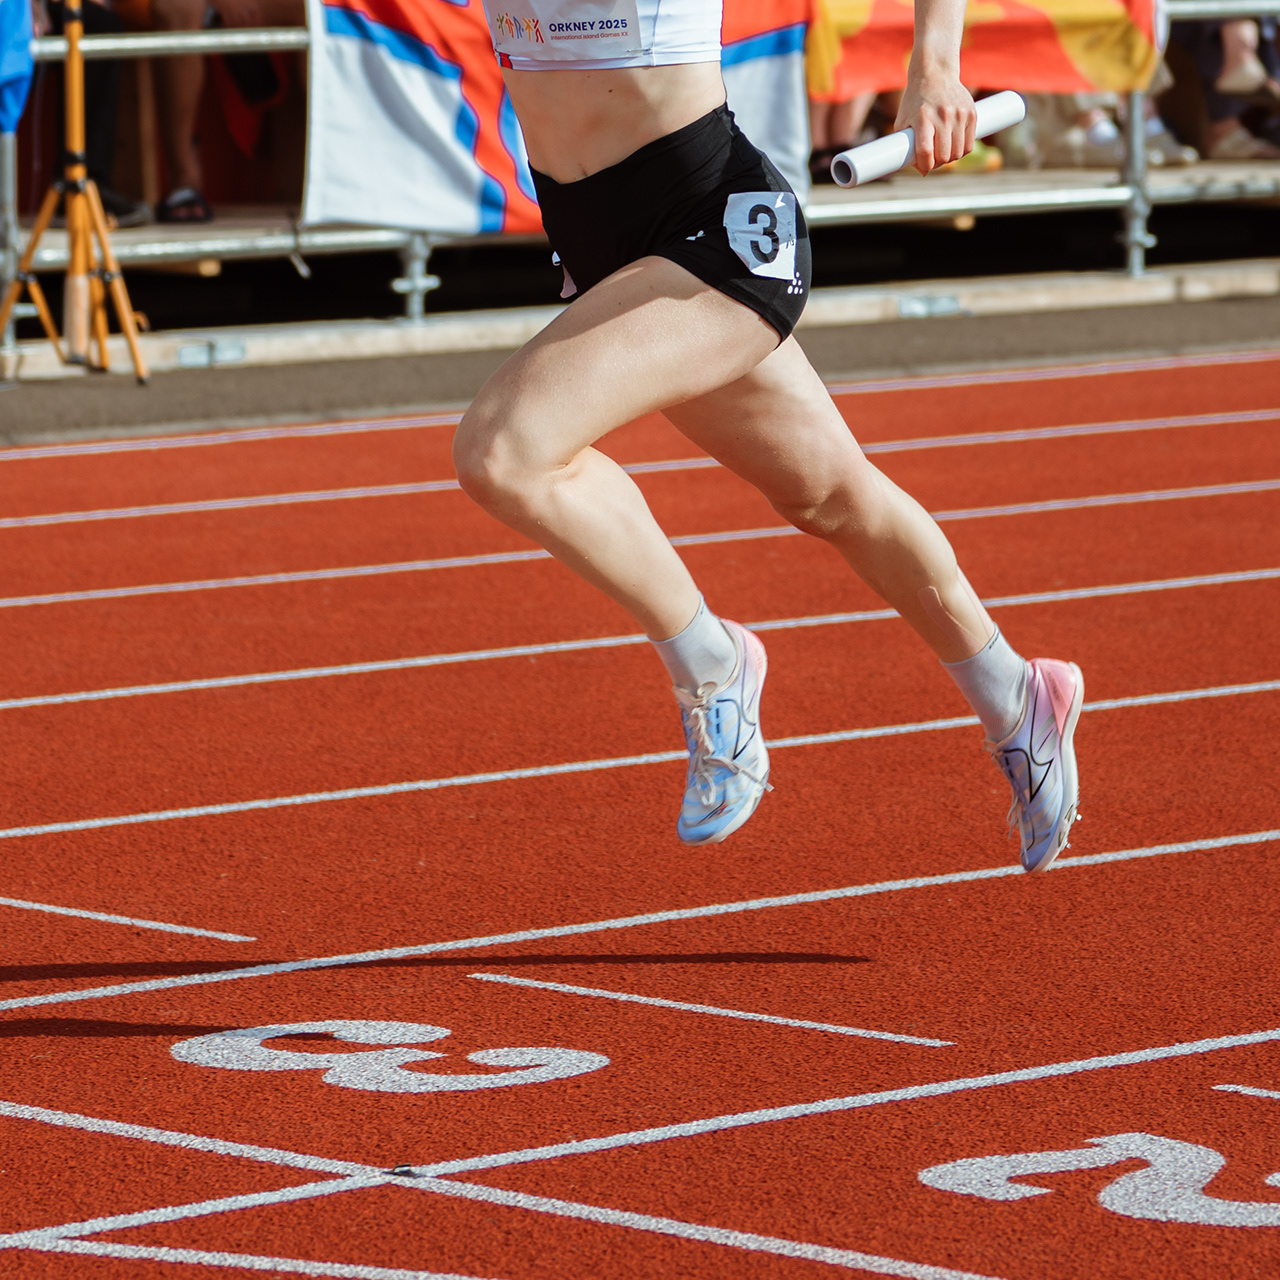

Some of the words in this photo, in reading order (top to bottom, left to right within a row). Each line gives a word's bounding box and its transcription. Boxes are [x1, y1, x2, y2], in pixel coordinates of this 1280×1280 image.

[549, 21, 595, 32] ORKNEY
[599, 19, 628, 30] 2025
[748, 204, 780, 264] 3
[169, 1020, 610, 1093] 3
